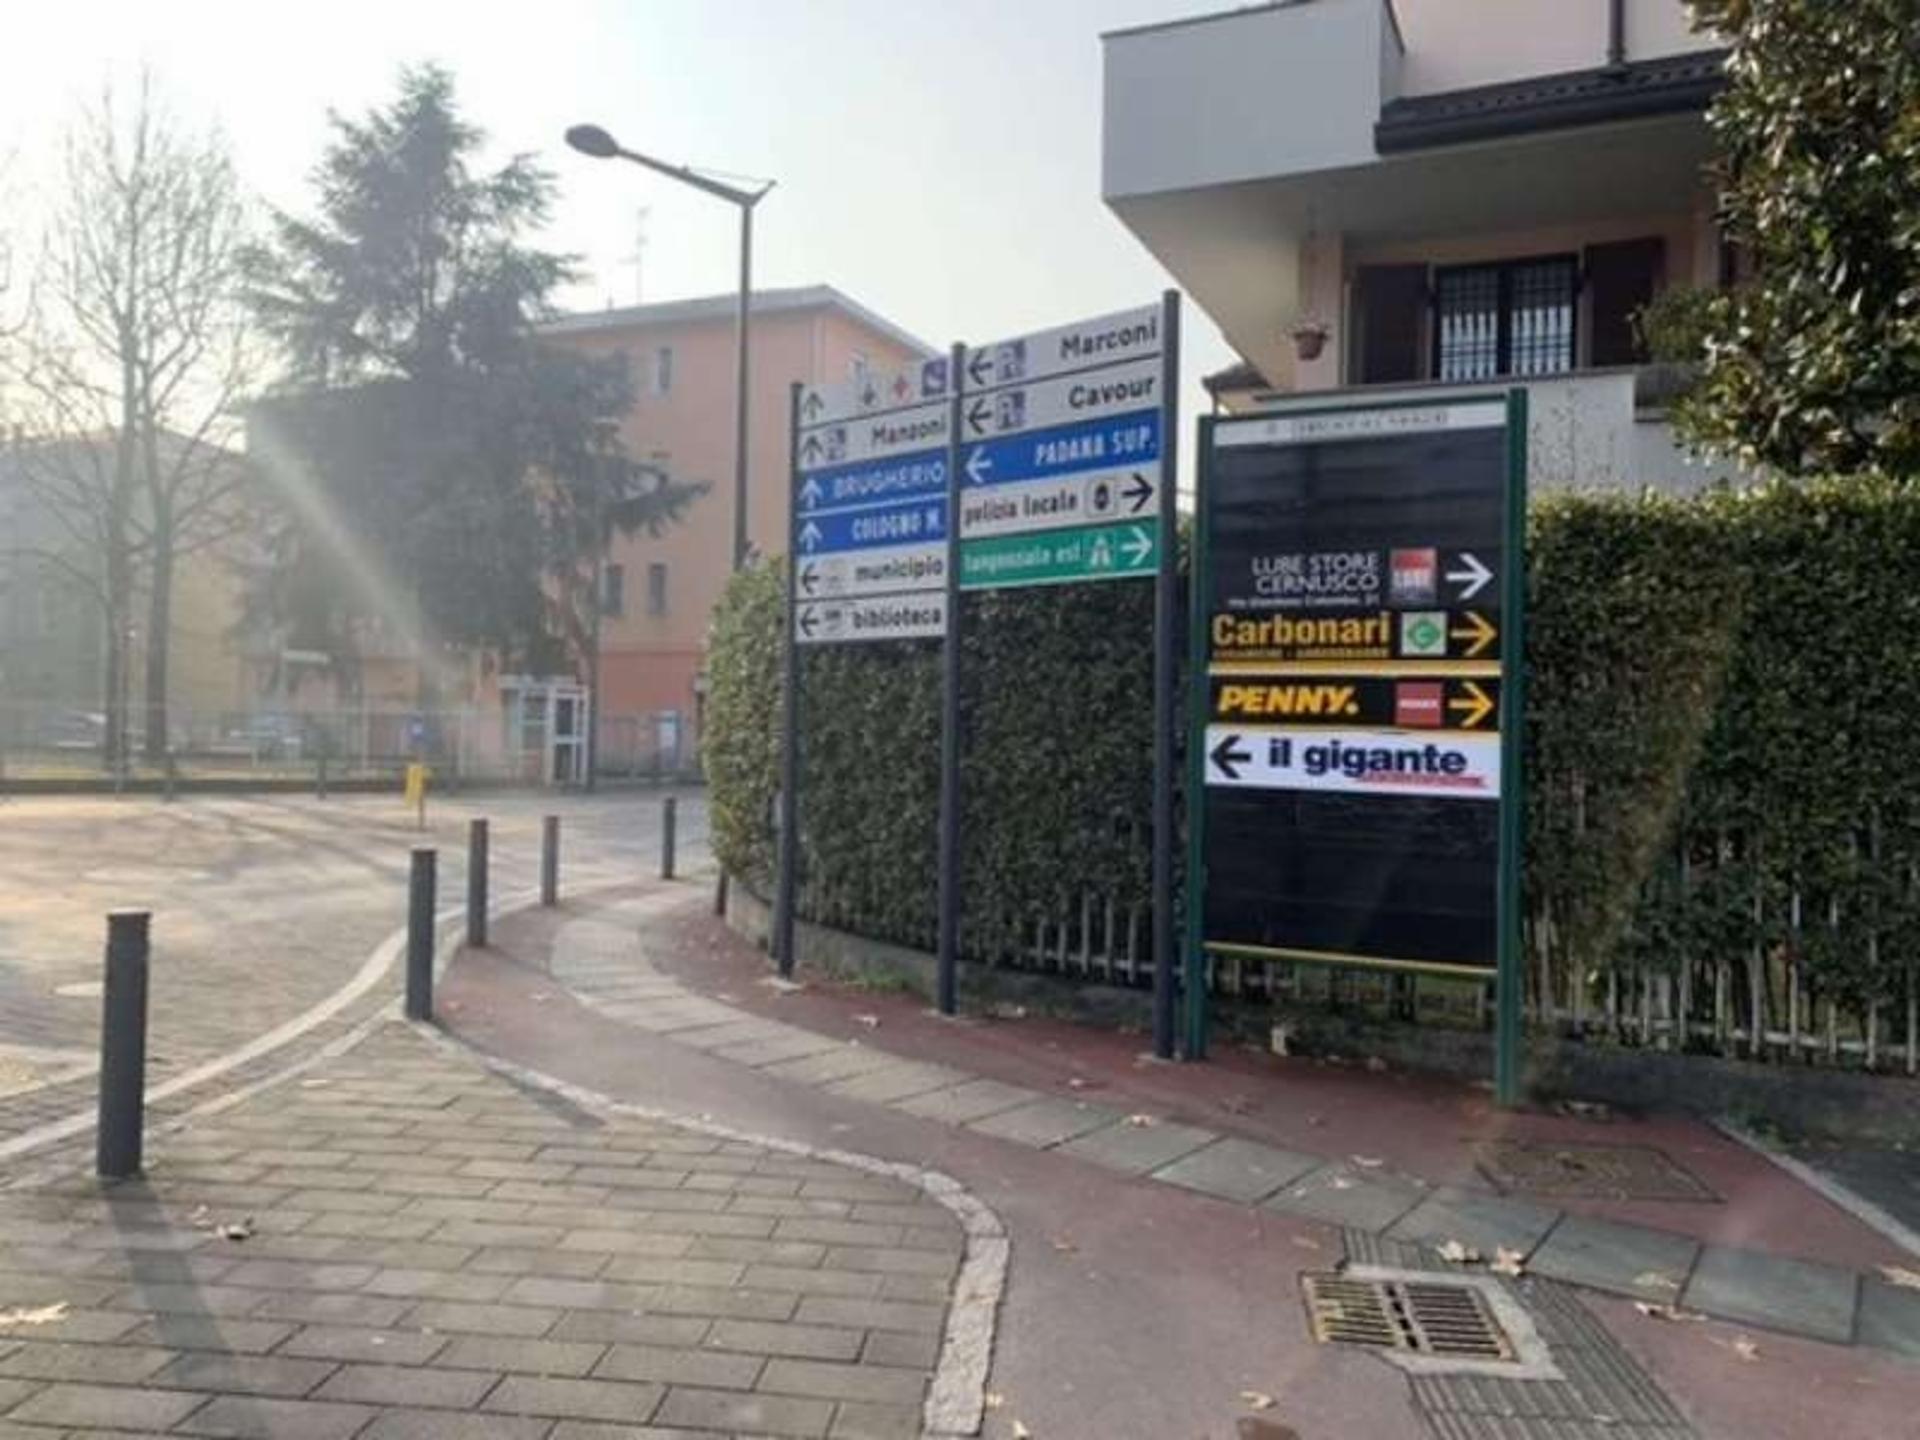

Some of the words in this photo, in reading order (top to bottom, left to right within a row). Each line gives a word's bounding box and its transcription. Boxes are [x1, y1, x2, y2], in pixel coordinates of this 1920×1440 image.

[1060, 317, 1157, 359] Marconi
[1068, 376, 1155, 409] Cavour
[872, 414, 946, 447] Manzoni
[1034, 433, 1105, 466] PADANA
[1112, 426, 1156, 456] SUP.
[833, 460, 945, 499] BRUGHERIO
[964, 499, 1018, 528] polizia
[1022, 488, 1077, 516] locale
[855, 555, 944, 582] municipio
[1252, 555, 1302, 576] LUBE
[1309, 551, 1380, 575] STORE
[1256, 572, 1380, 595] CERNUSCO
[852, 605, 942, 629] biblioteca
[1211, 611, 1391, 646] Carbonari
[1218, 685, 1359, 714] PENNY.
[1269, 738, 1292, 768] il
[1304, 740, 1468, 777] gigante
